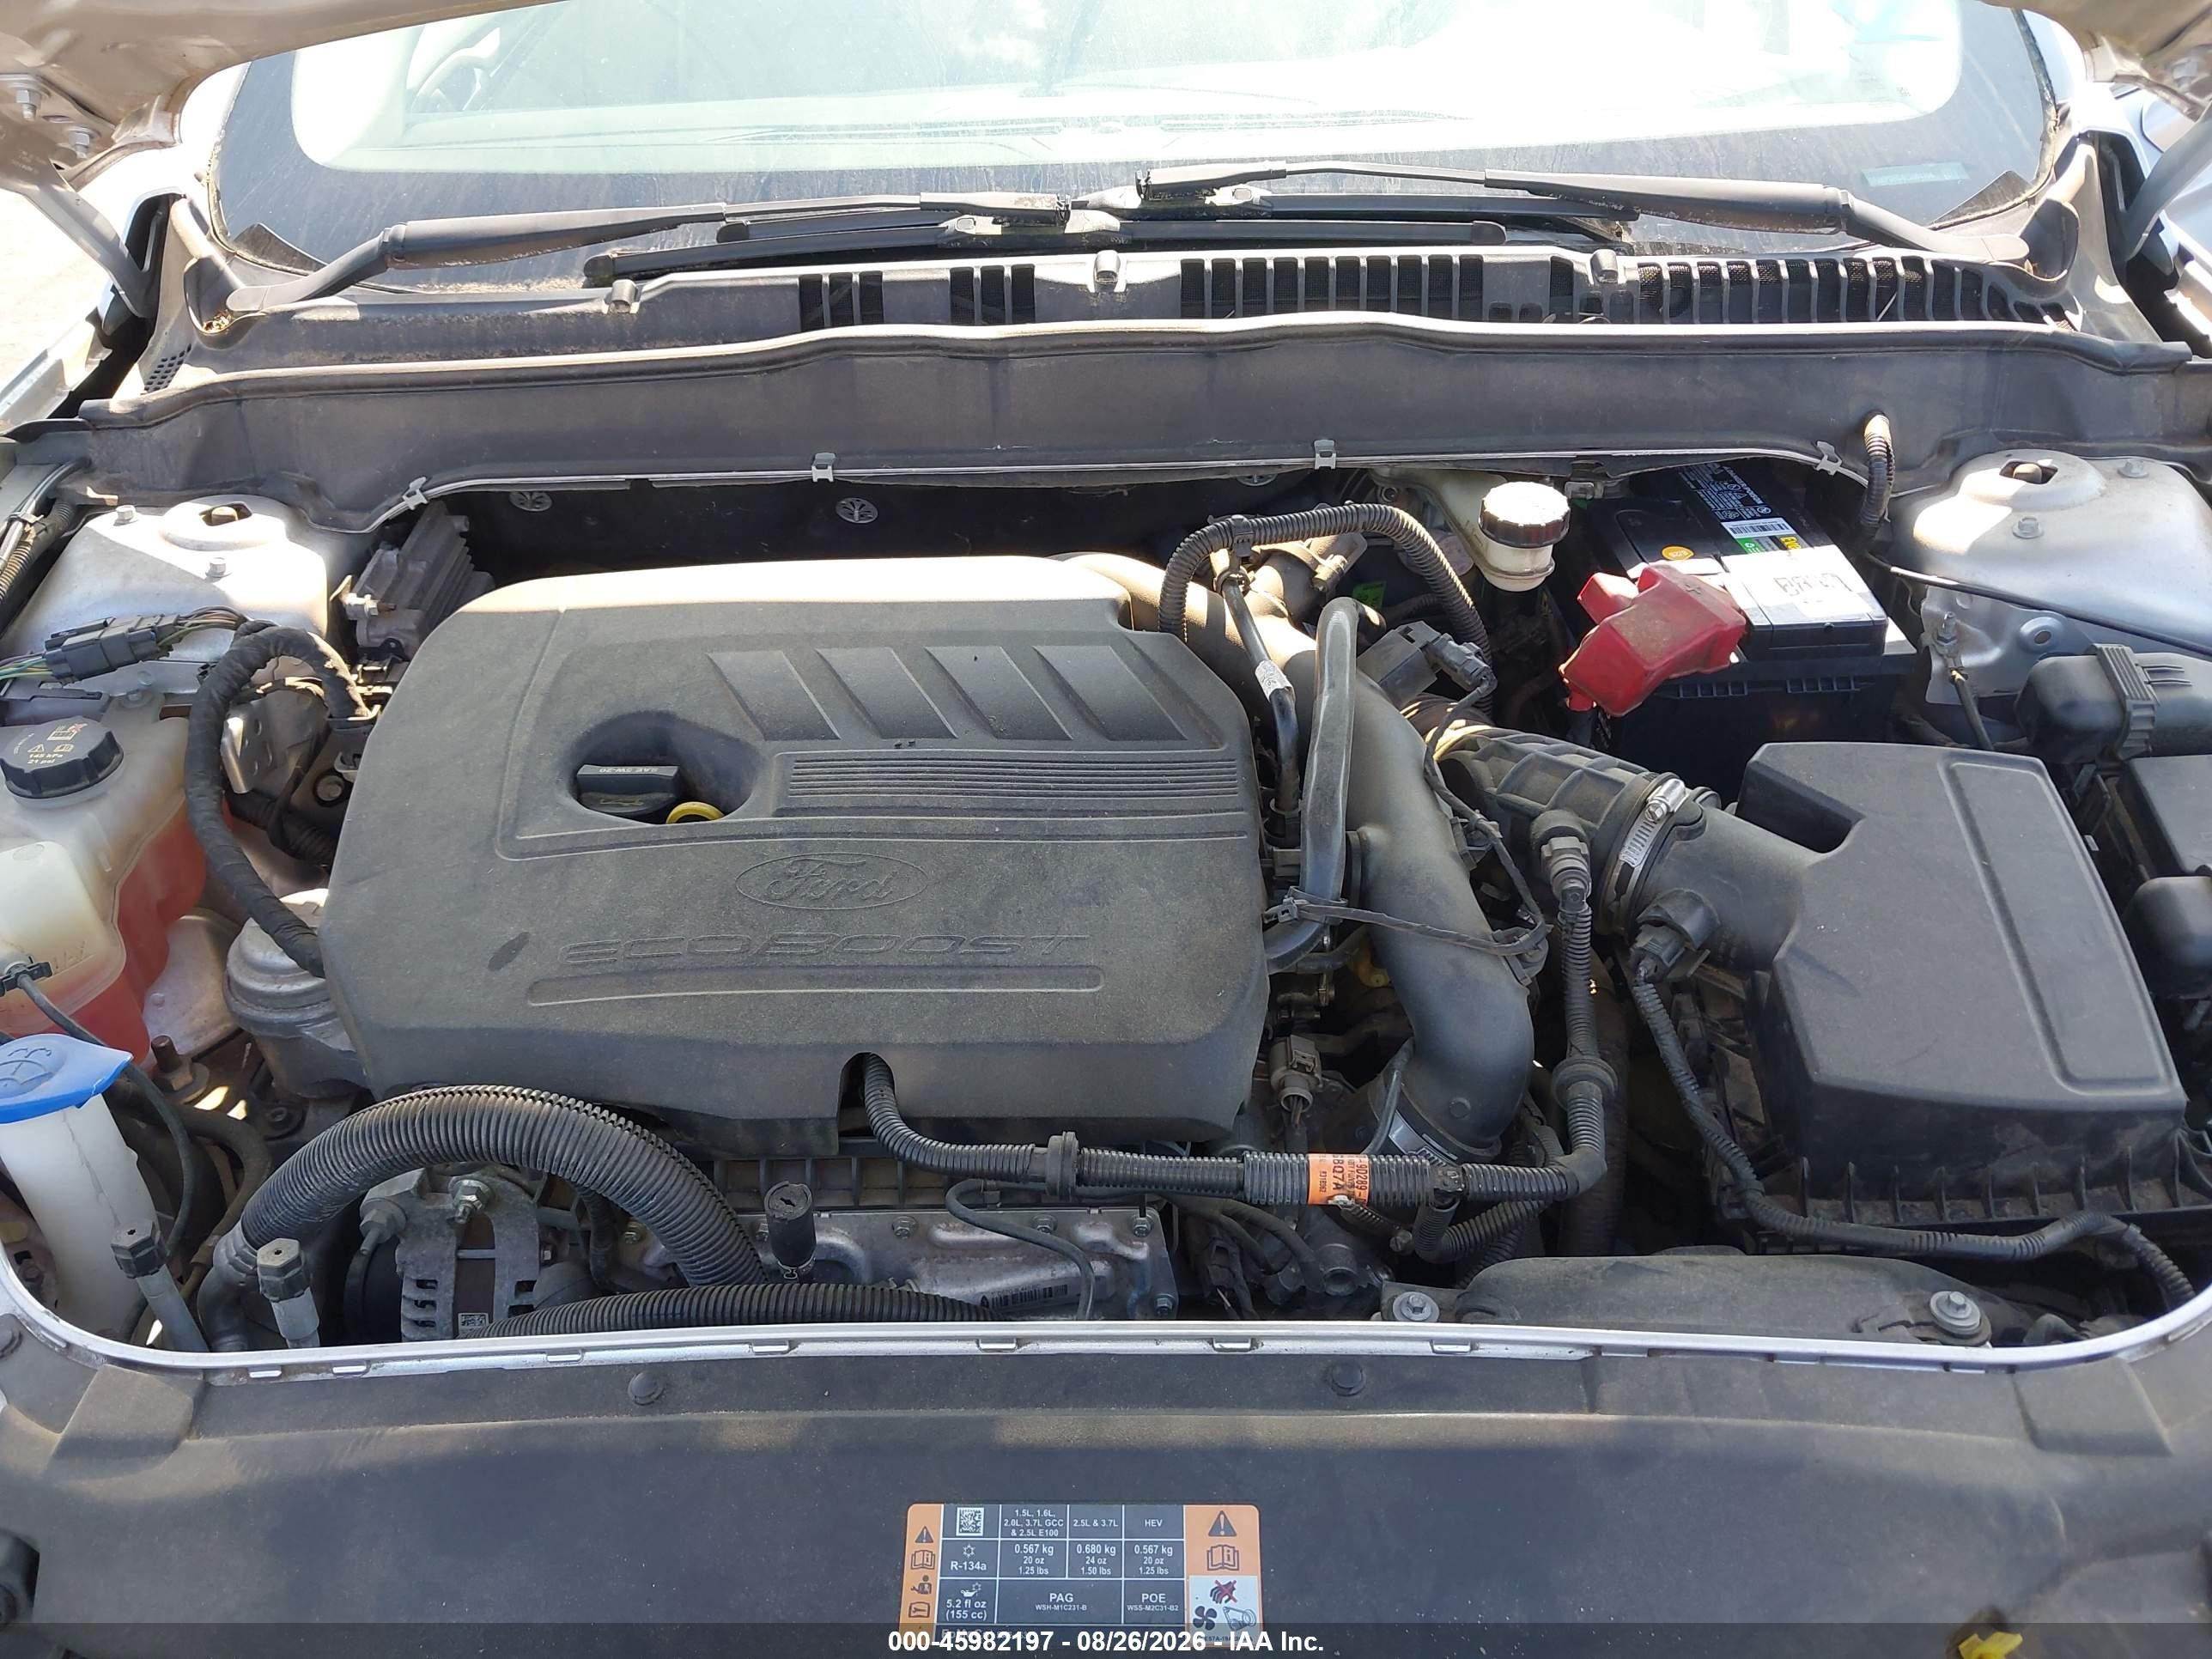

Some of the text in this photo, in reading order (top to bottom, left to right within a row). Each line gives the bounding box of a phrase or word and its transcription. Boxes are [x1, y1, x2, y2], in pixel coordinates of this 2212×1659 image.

[767, 857, 901, 901] Ford
[559, 932, 1090, 964] ECOBOOST
[1014, 1509, 1056, 1518] 1.5L, 1.6L,
[1003, 1518, 1064, 1528] 2.0L, 3.7L GCC
[1073, 1518, 1119, 1527] 2.5L & 3.7L
[1144, 1518, 1163, 1528] HEV
[1010, 1528, 1059, 1537] & 2.5L E100
[1014, 1544, 1054, 1556] 0.567 kg
[1076, 1544, 1116, 1556] 0.680 kg
[1133, 1544, 1173, 1557] 0.567 kg
[1023, 1556, 1033, 1565] 20
[1085, 1556, 1096, 1565] 24
[1143, 1556, 1153, 1565] 20
[950, 1560, 988, 1571] R-134a
[1018, 1566, 1049, 1575] 1.25 lbs
[1080, 1566, 1111, 1575] 1.50 lbs
[1139, 1566, 1169, 1575] 1.25 lbs
[1049, 1593, 1074, 1602] PAG
[1141, 1593, 1166, 1603] POE
[946, 1599, 962, 1608] 5.2
[964, 1599, 971, 1608] fl
[945, 1609, 988, 1621] (155 cc)
